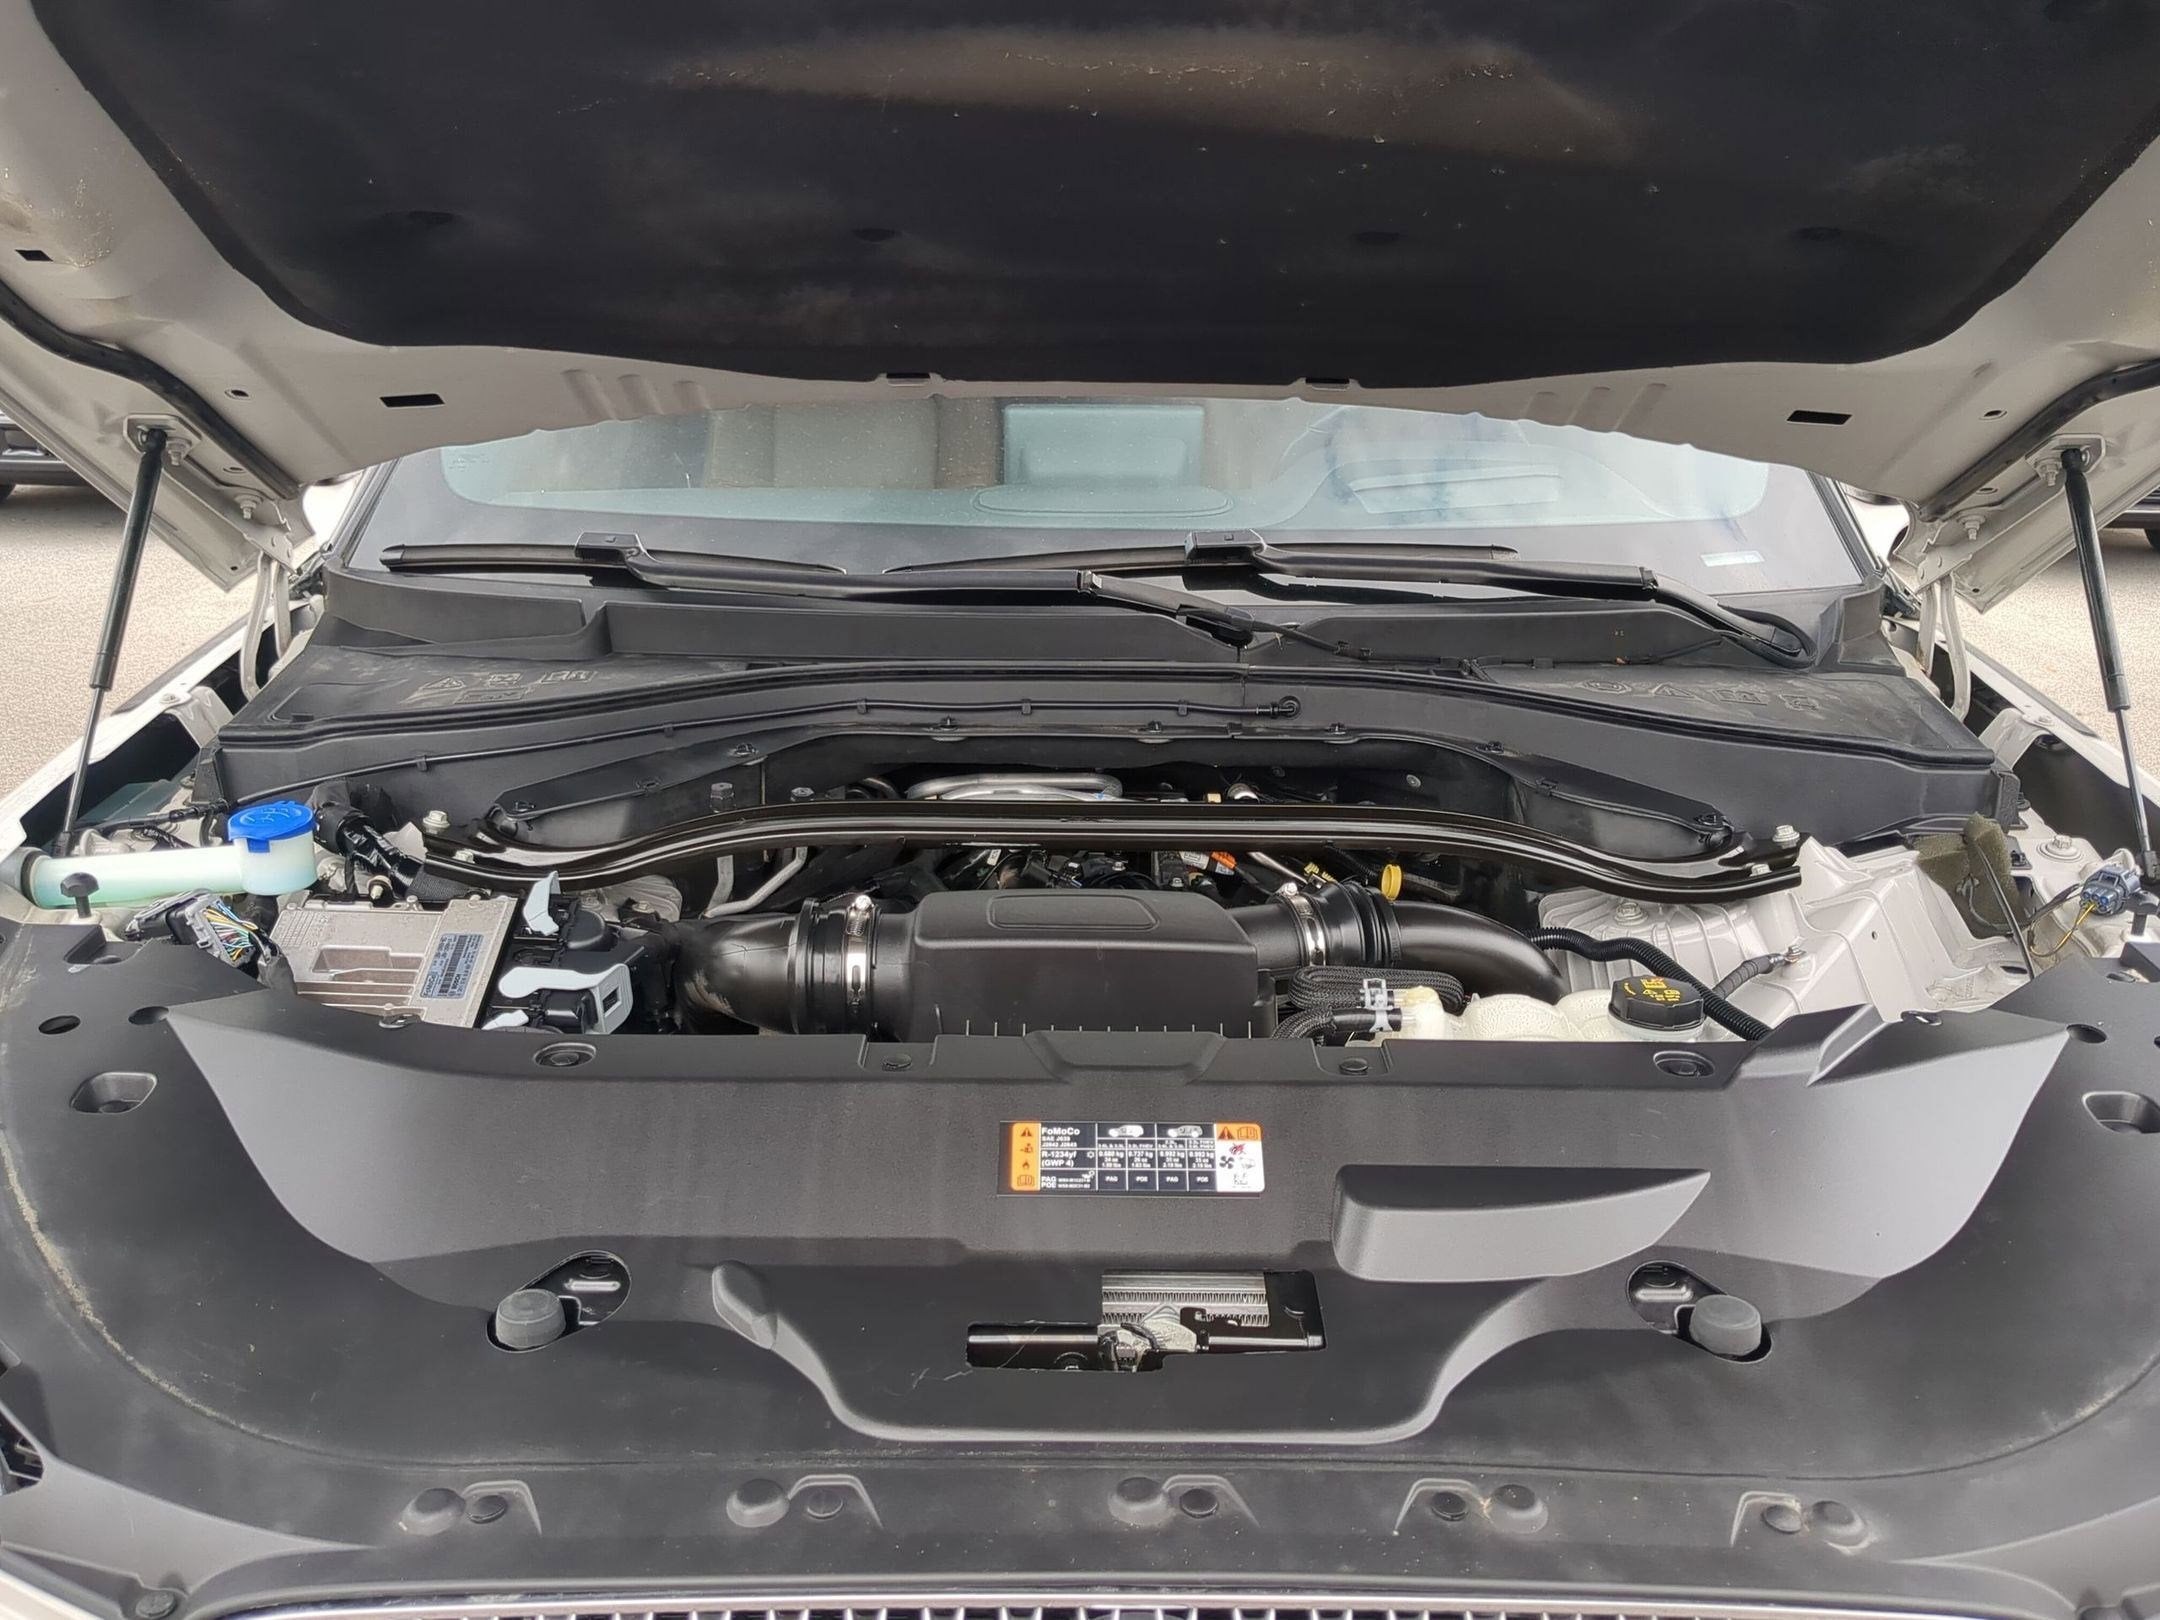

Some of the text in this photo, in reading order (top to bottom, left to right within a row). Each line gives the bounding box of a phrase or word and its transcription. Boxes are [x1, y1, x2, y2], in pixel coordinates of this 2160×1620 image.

[1041, 1127, 1080, 1136] FoMoCo
[1041, 1150, 1077, 1159] R-1234yf
[1041, 1159, 1074, 1167] (GWP 4)
